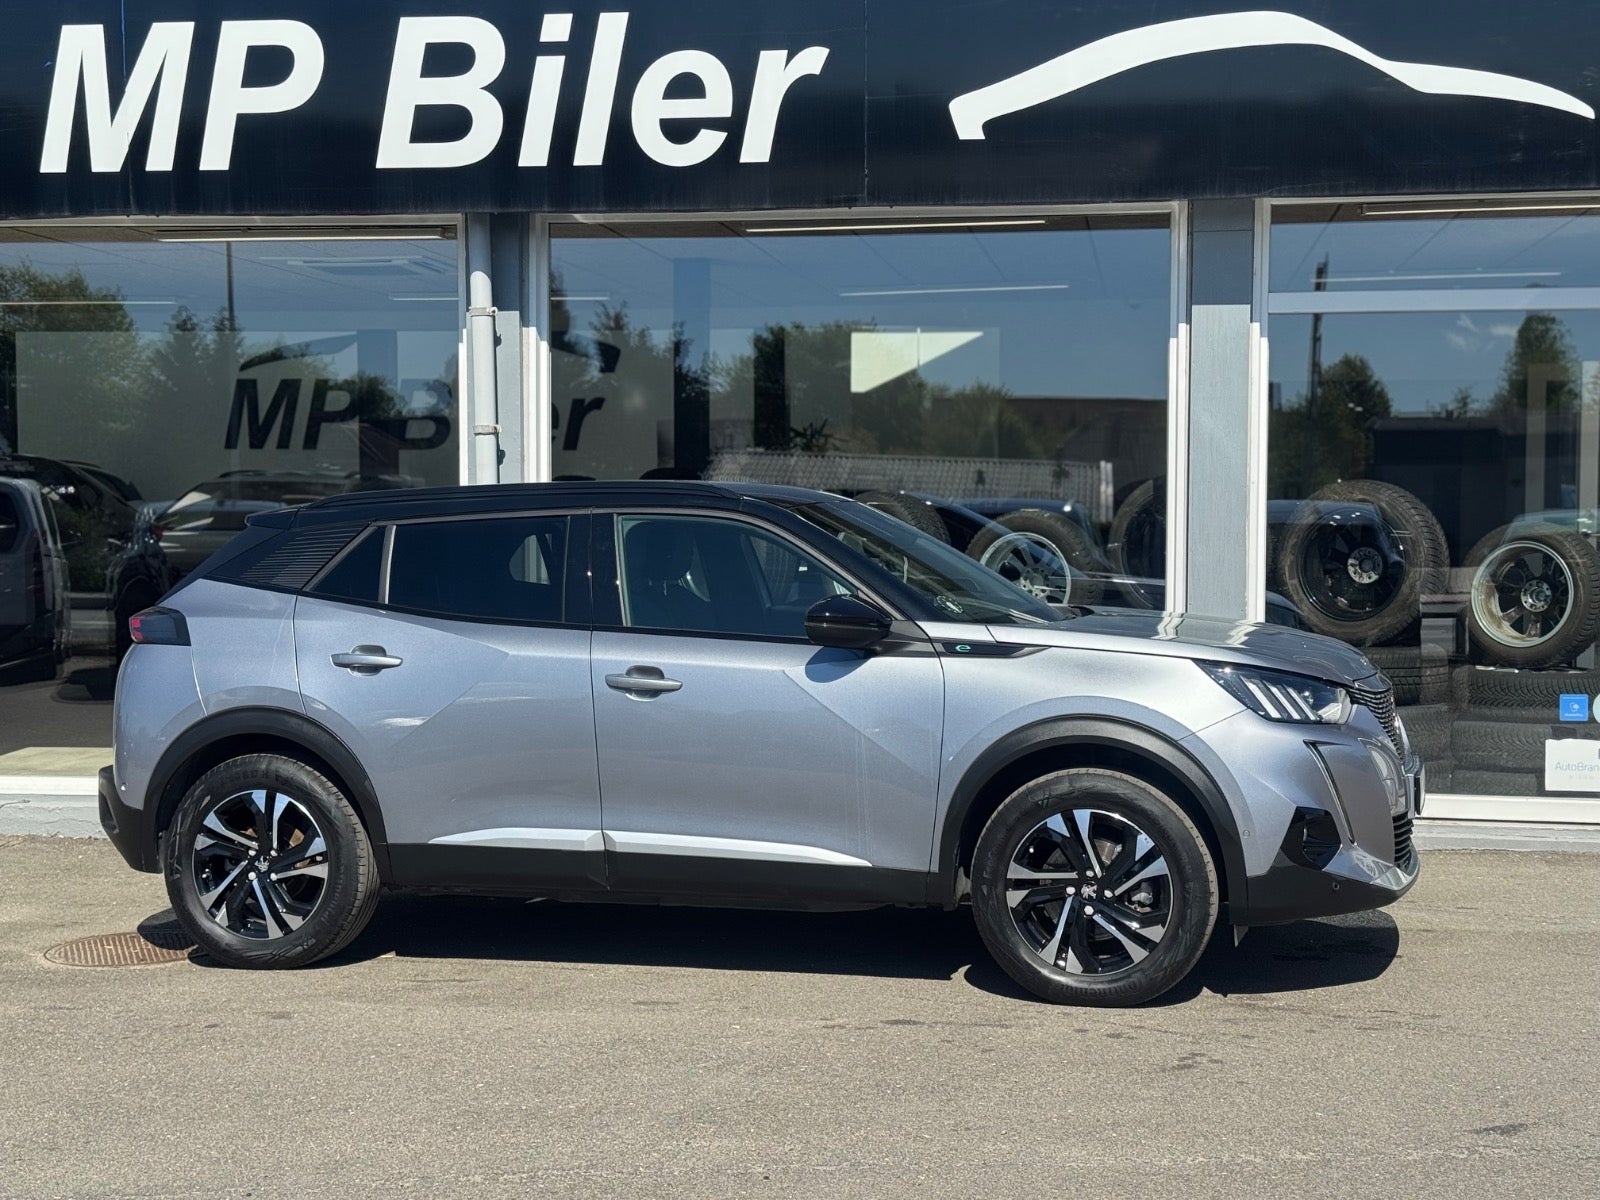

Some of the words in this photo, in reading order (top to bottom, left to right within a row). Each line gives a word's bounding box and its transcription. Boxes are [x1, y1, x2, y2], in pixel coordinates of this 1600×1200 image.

[40, 20, 324, 173] MP
[376, 12, 829, 168] Biler
[224, 378, 362, 449] MP
